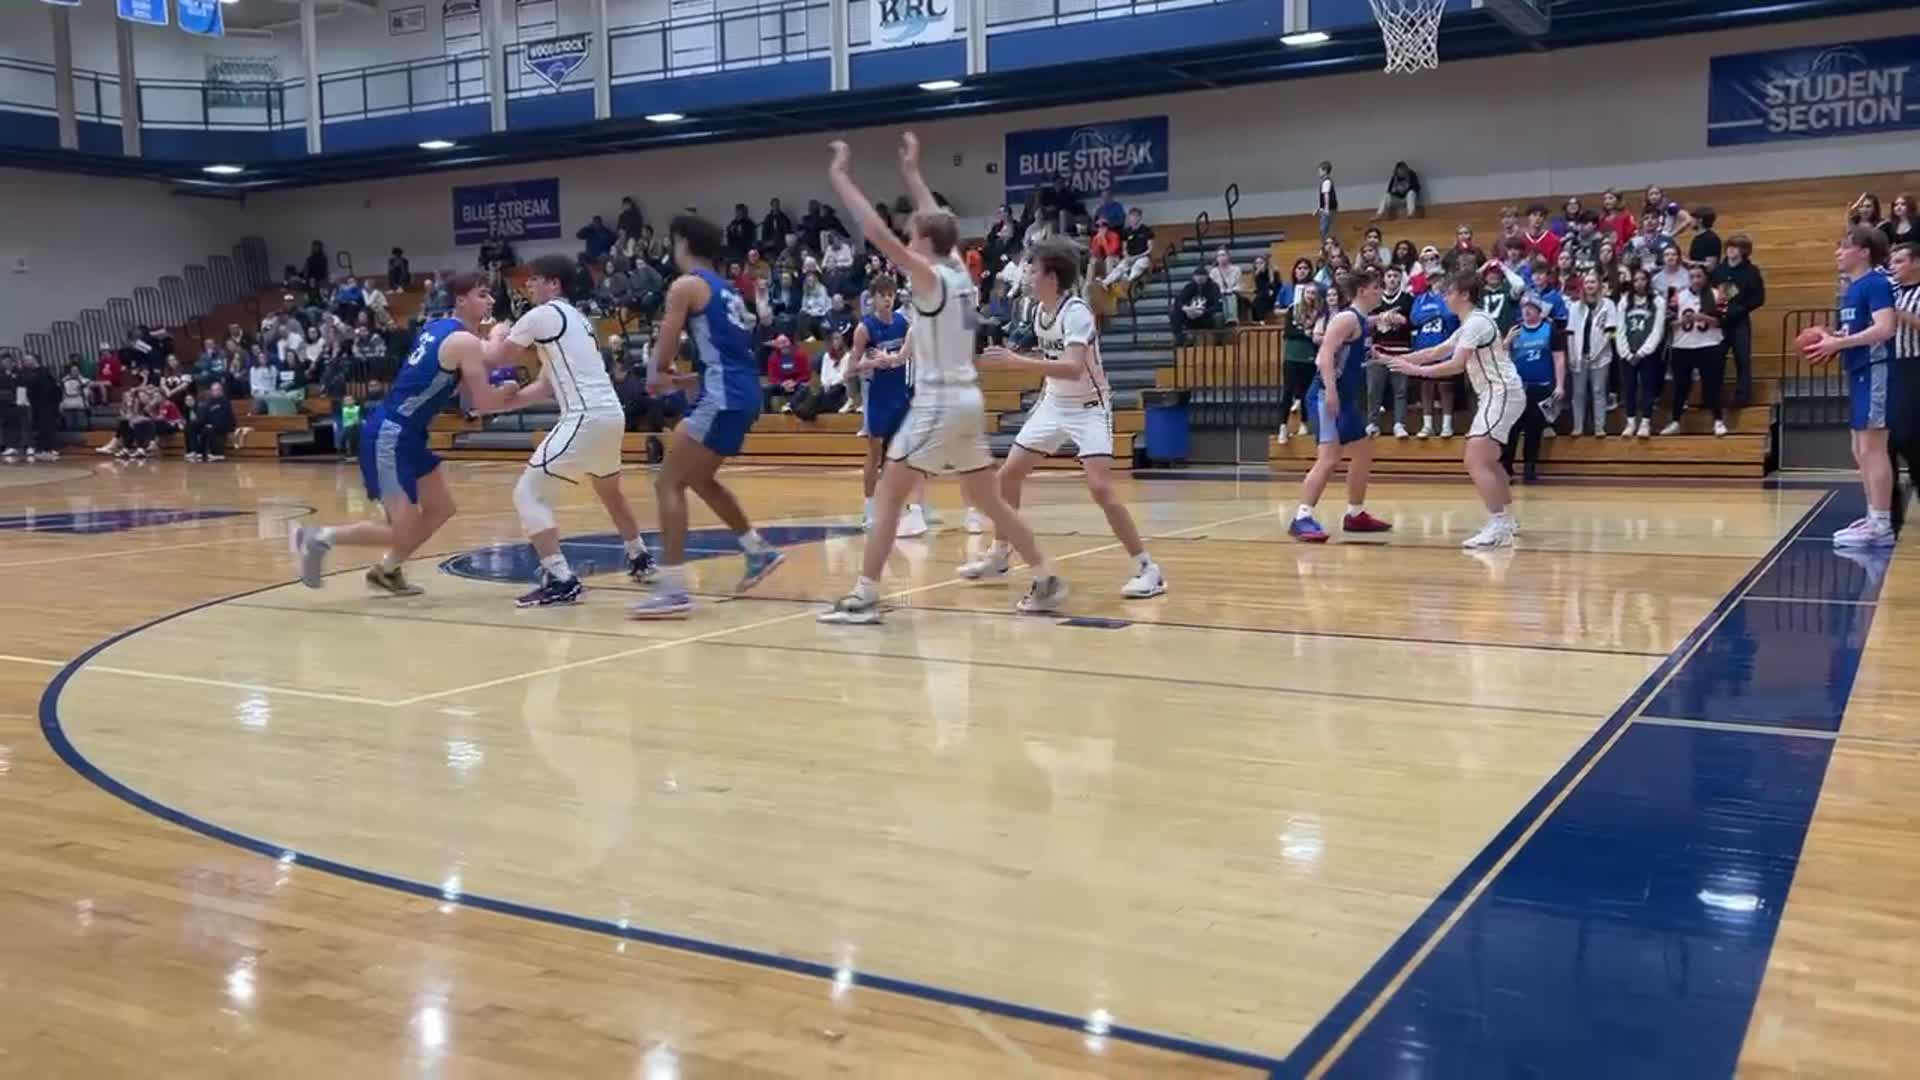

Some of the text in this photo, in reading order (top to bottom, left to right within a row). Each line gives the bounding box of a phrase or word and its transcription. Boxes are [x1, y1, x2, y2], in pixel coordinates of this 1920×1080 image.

[1764, 66, 1911, 106] STUDENT
[1767, 95, 1903, 133] SECTION
[1019, 138, 1153, 177] BLUE STREAK
[1061, 169, 1112, 192] ANS
[463, 198, 551, 222] BLUE STREAK
[489, 219, 525, 237] FANS
[1483, 293, 1505, 319] 17
